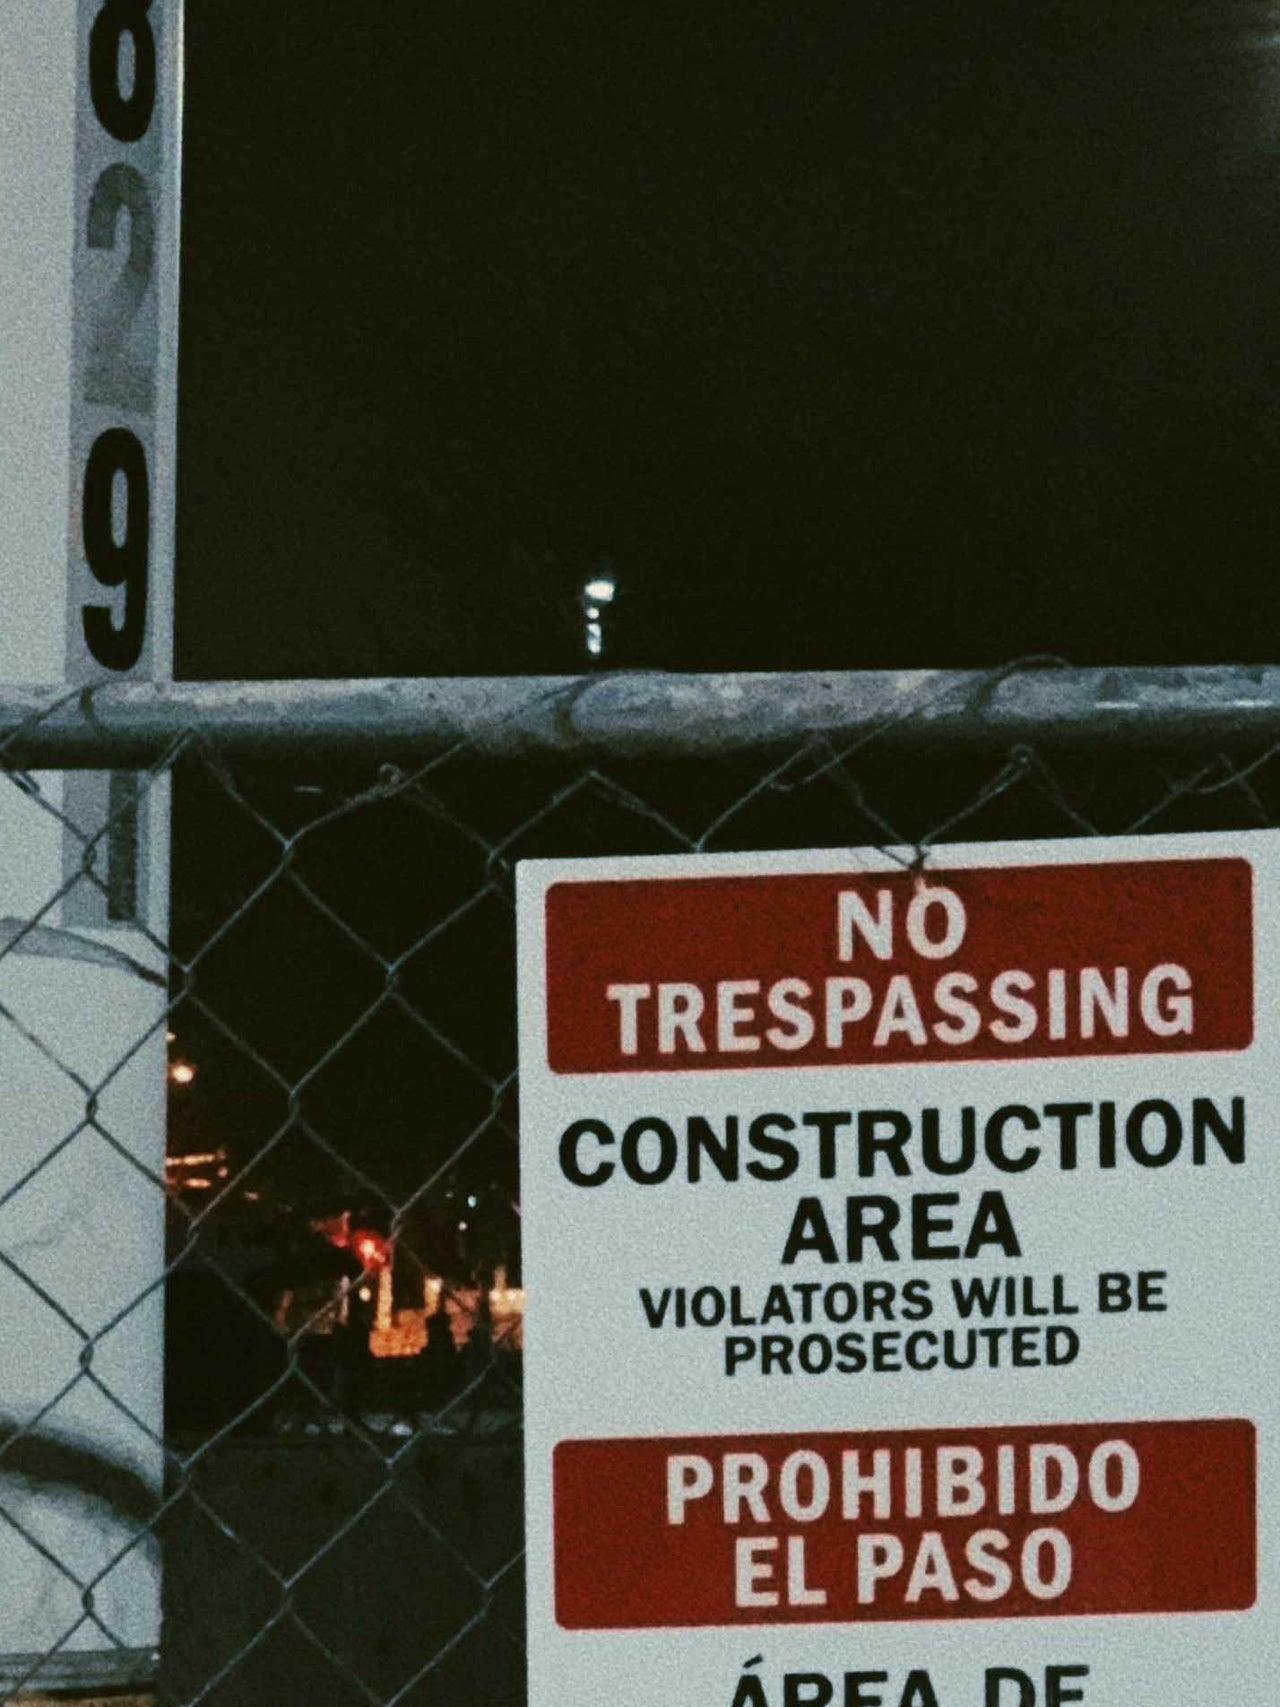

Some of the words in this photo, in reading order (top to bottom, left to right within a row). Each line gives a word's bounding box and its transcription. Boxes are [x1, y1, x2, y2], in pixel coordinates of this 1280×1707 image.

[837, 884, 967, 962] NO
[606, 963, 1195, 1055] TRESPASSING
[558, 1095, 1246, 1188] CONSTRUCTION
[781, 1190, 1022, 1265] AREA
[639, 1278, 934, 1329] VIOLATORS
[951, 1274, 1079, 1318] WILL
[1098, 1270, 1168, 1314] BE
[724, 1325, 1081, 1376] PROSECUTED
[666, 1439, 1140, 1525] PROHIBIDO
[735, 1535, 827, 1607] EL
[856, 1527, 1072, 1604] PASO
